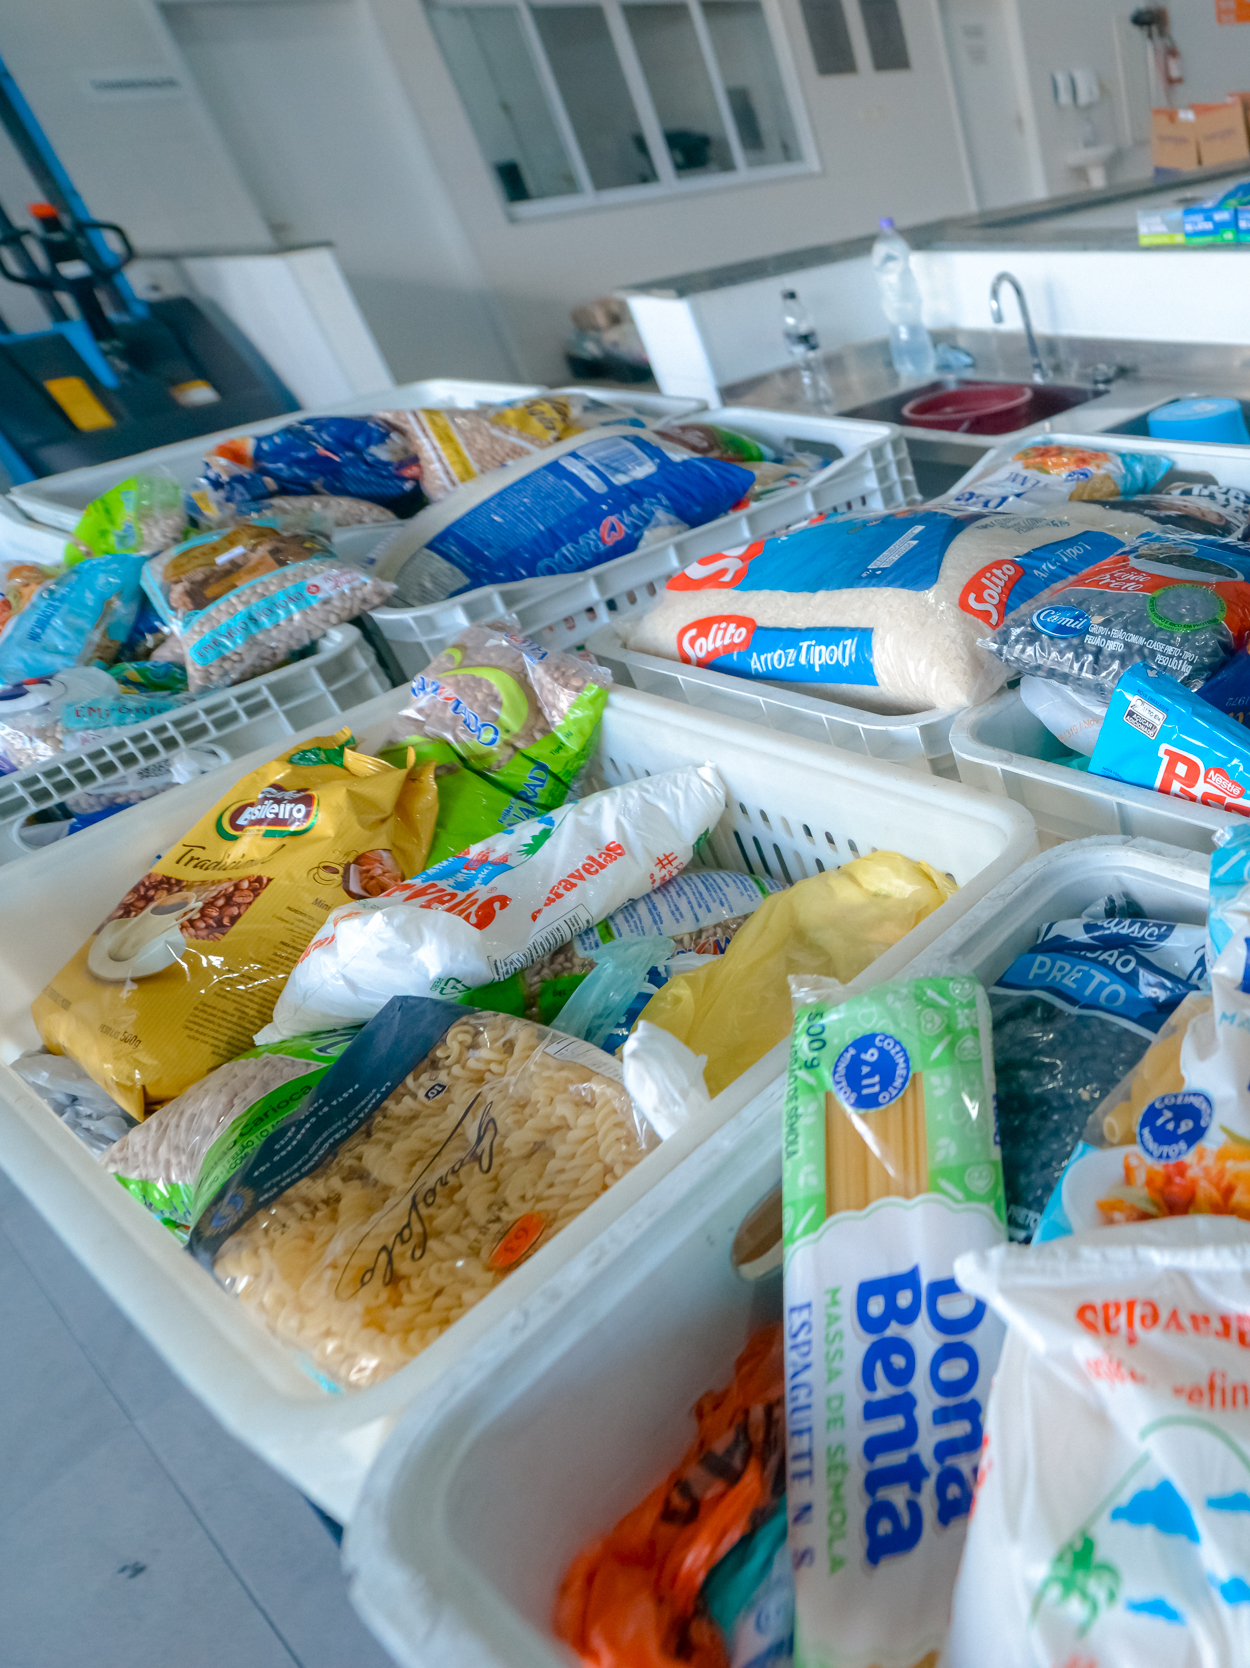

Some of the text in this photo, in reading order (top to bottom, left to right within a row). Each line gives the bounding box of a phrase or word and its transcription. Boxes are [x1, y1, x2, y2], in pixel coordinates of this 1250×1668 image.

[1056, 546, 1084, 564] Tipo
[968, 563, 1016, 625] Solito
[1086, 574, 1143, 591] Preto
[682, 622, 747, 666] Solito
[751, 649, 795, 674] Arroz
[800, 641, 837, 671] Tipo
[1085, 635, 1124, 651] FEIJÃO PRETO
[1147, 640, 1165, 652] CLASSE
[1164, 645, 1180, 656] PRETO
[1182, 651, 1194, 661] TIPO
[1155, 655, 1169, 666] PESO
[1226, 697, 1250, 707] 1972
[550, 743, 562, 756] Tipo
[1208, 769, 1241, 796] Nestlé
[1028, 955, 1127, 1007] PRETO
[806, 1011, 827, 1051] 500
[860, 1048, 879, 1062] 9
[874, 1034, 909, 1104] COZIMENTO
[834, 1046, 857, 1105] MINUTOS
[861, 1074, 880, 1095] 11
[236, 1081, 313, 1139] Carioca
[330, 1082, 359, 1107] PASTA
[1154, 1093, 1212, 1127] COZIMENTO
[785, 1107, 802, 1160] SÊMOLA
[1156, 1109, 1173, 1126] 7
[1177, 1119, 1194, 1134] 9
[1141, 1126, 1188, 1160] MINUTOS
[856, 1263, 931, 1566] Benta
[925, 1277, 987, 1527] Dona
[824, 1286, 848, 1578] MASSA DE SÊMOLA
